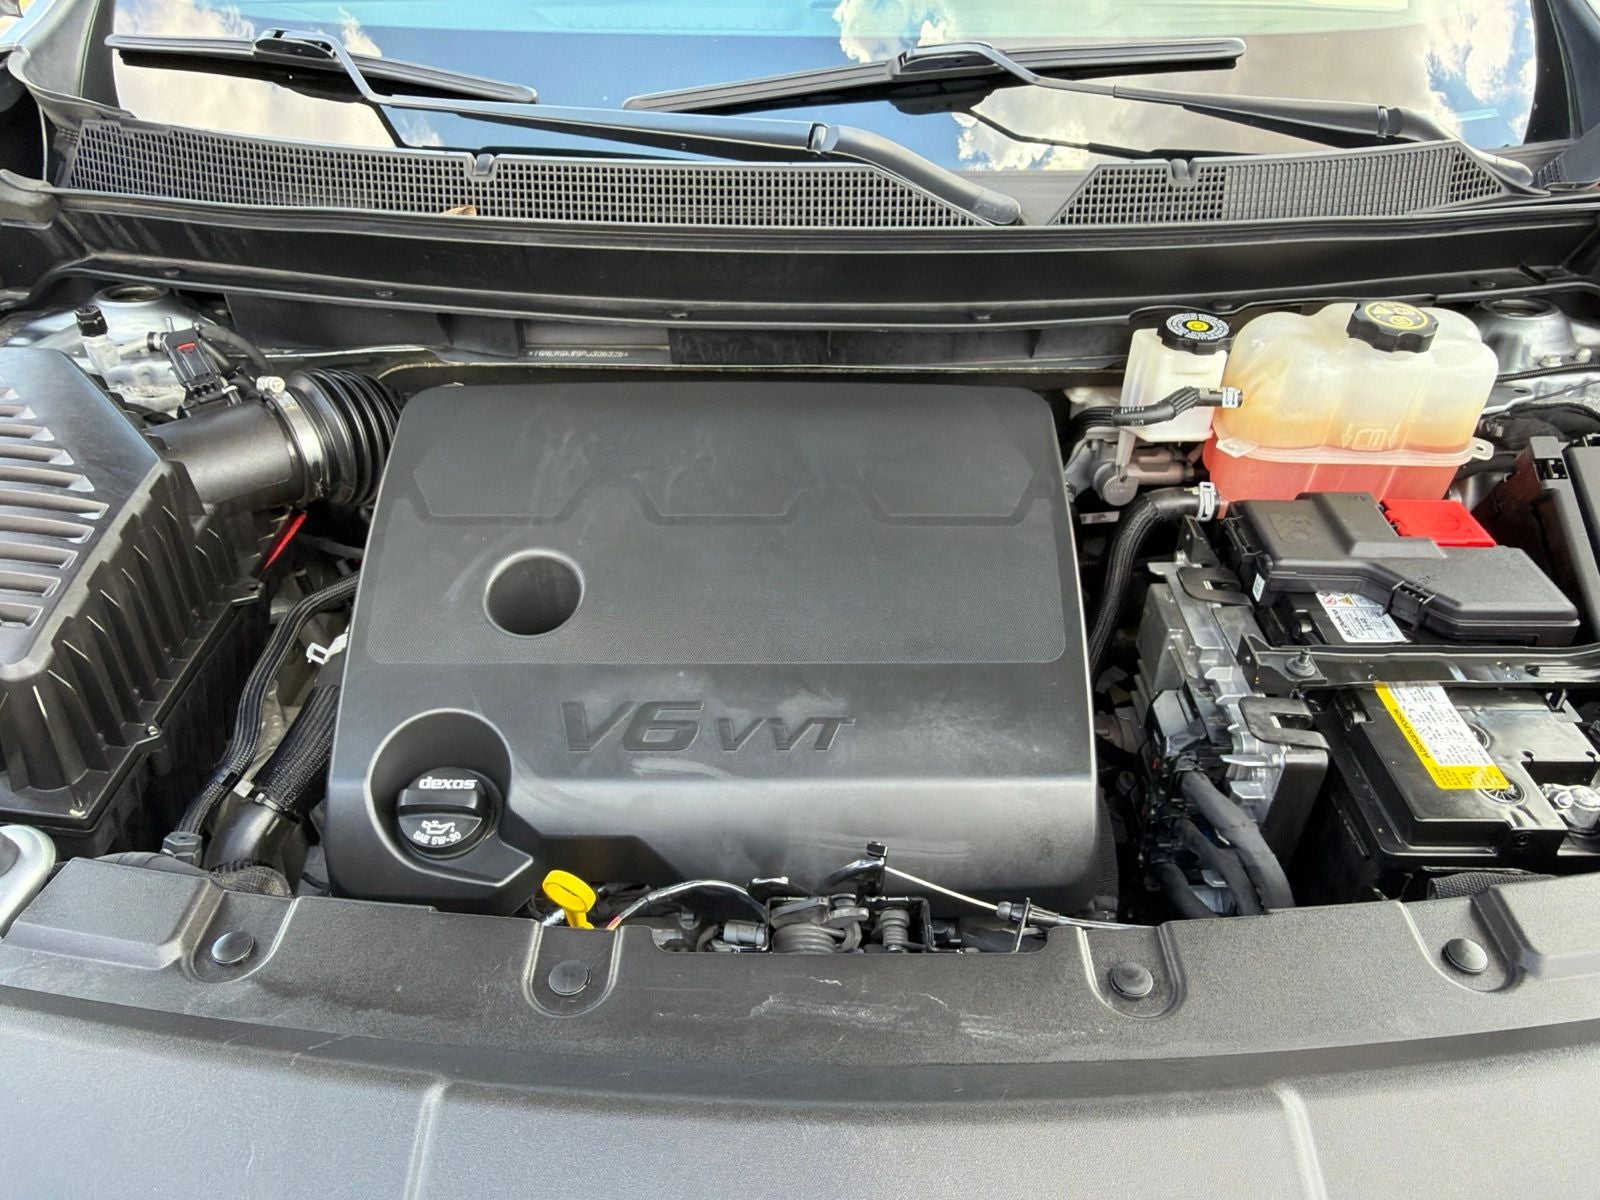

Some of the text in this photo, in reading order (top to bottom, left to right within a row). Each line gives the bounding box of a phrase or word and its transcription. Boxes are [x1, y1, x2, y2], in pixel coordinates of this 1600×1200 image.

[560, 701, 856, 751] V6 VVT
[418, 776, 478, 790] dexos
[413, 830, 462, 846] SAE 5W-30
